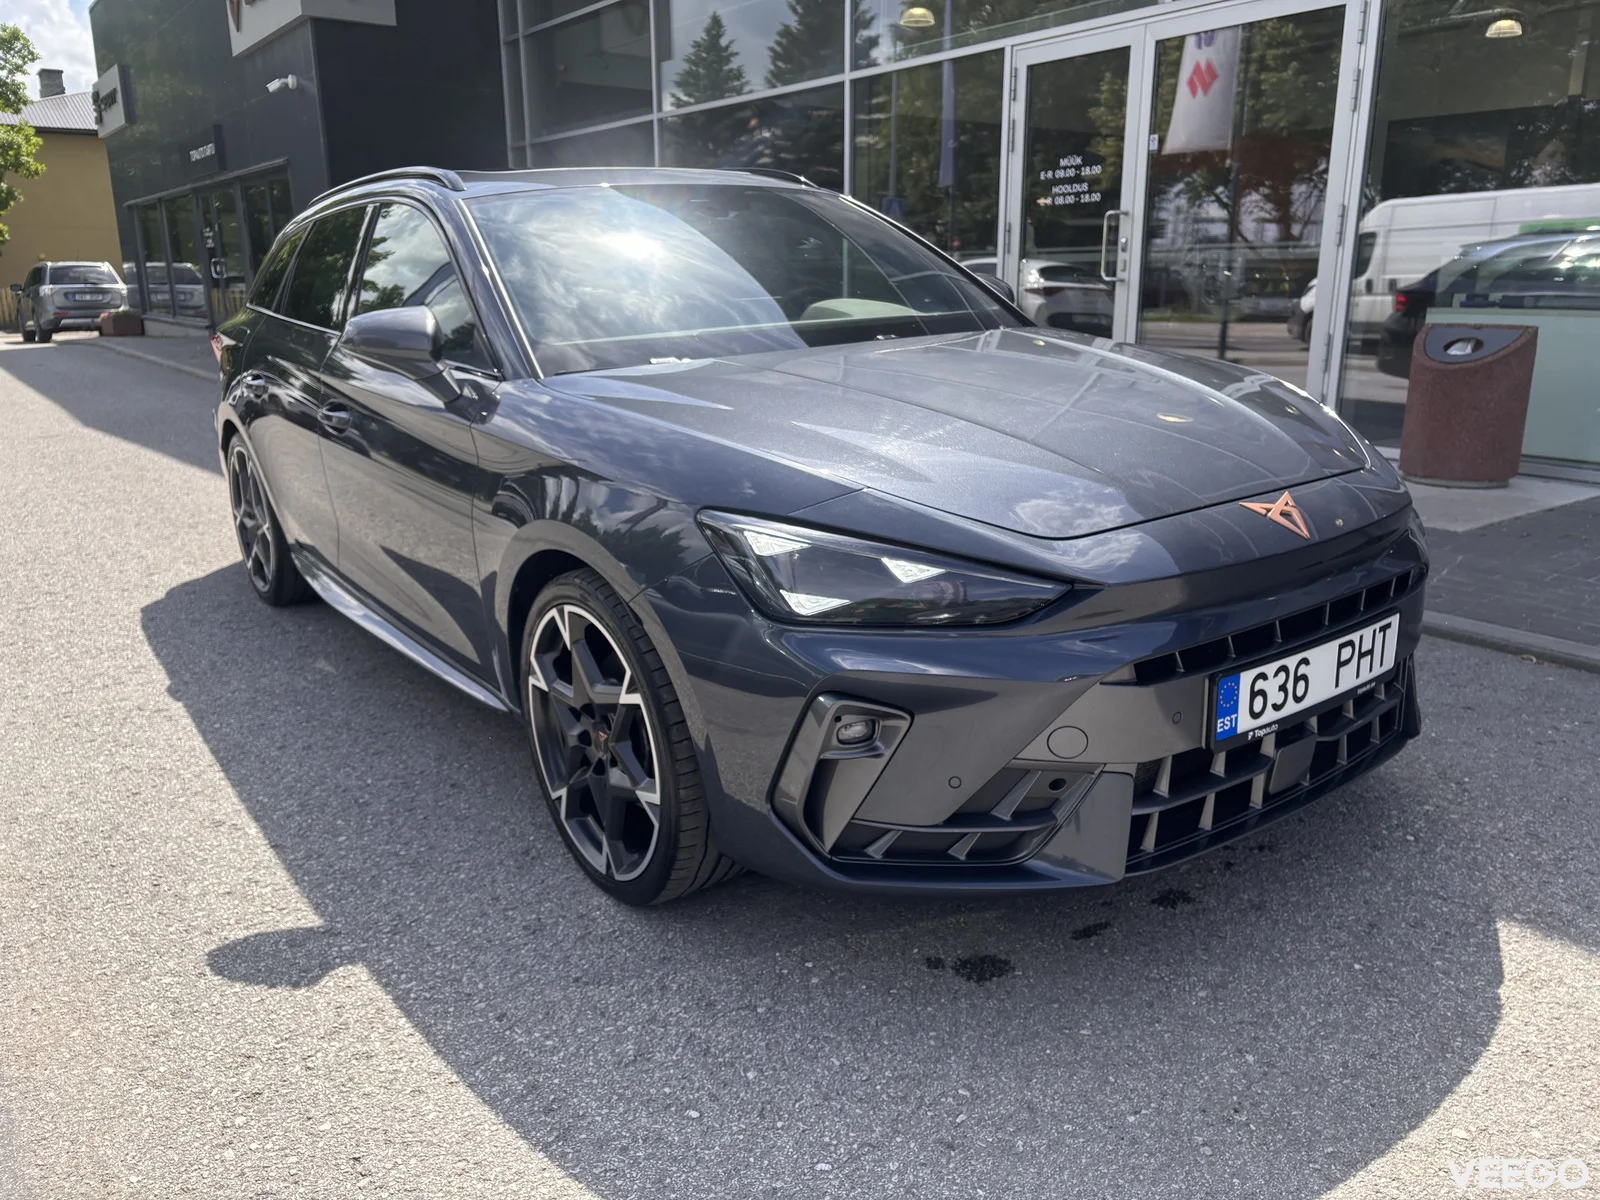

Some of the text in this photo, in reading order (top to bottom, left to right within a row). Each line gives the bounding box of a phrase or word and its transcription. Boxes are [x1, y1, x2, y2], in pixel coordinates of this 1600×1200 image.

[1052, 182, 1089, 193] HOOLDUS
[1249, 622, 1392, 720] 636 PHT
[1217, 713, 1238, 733] EST
[1255, 723, 1279, 738] Topauto
